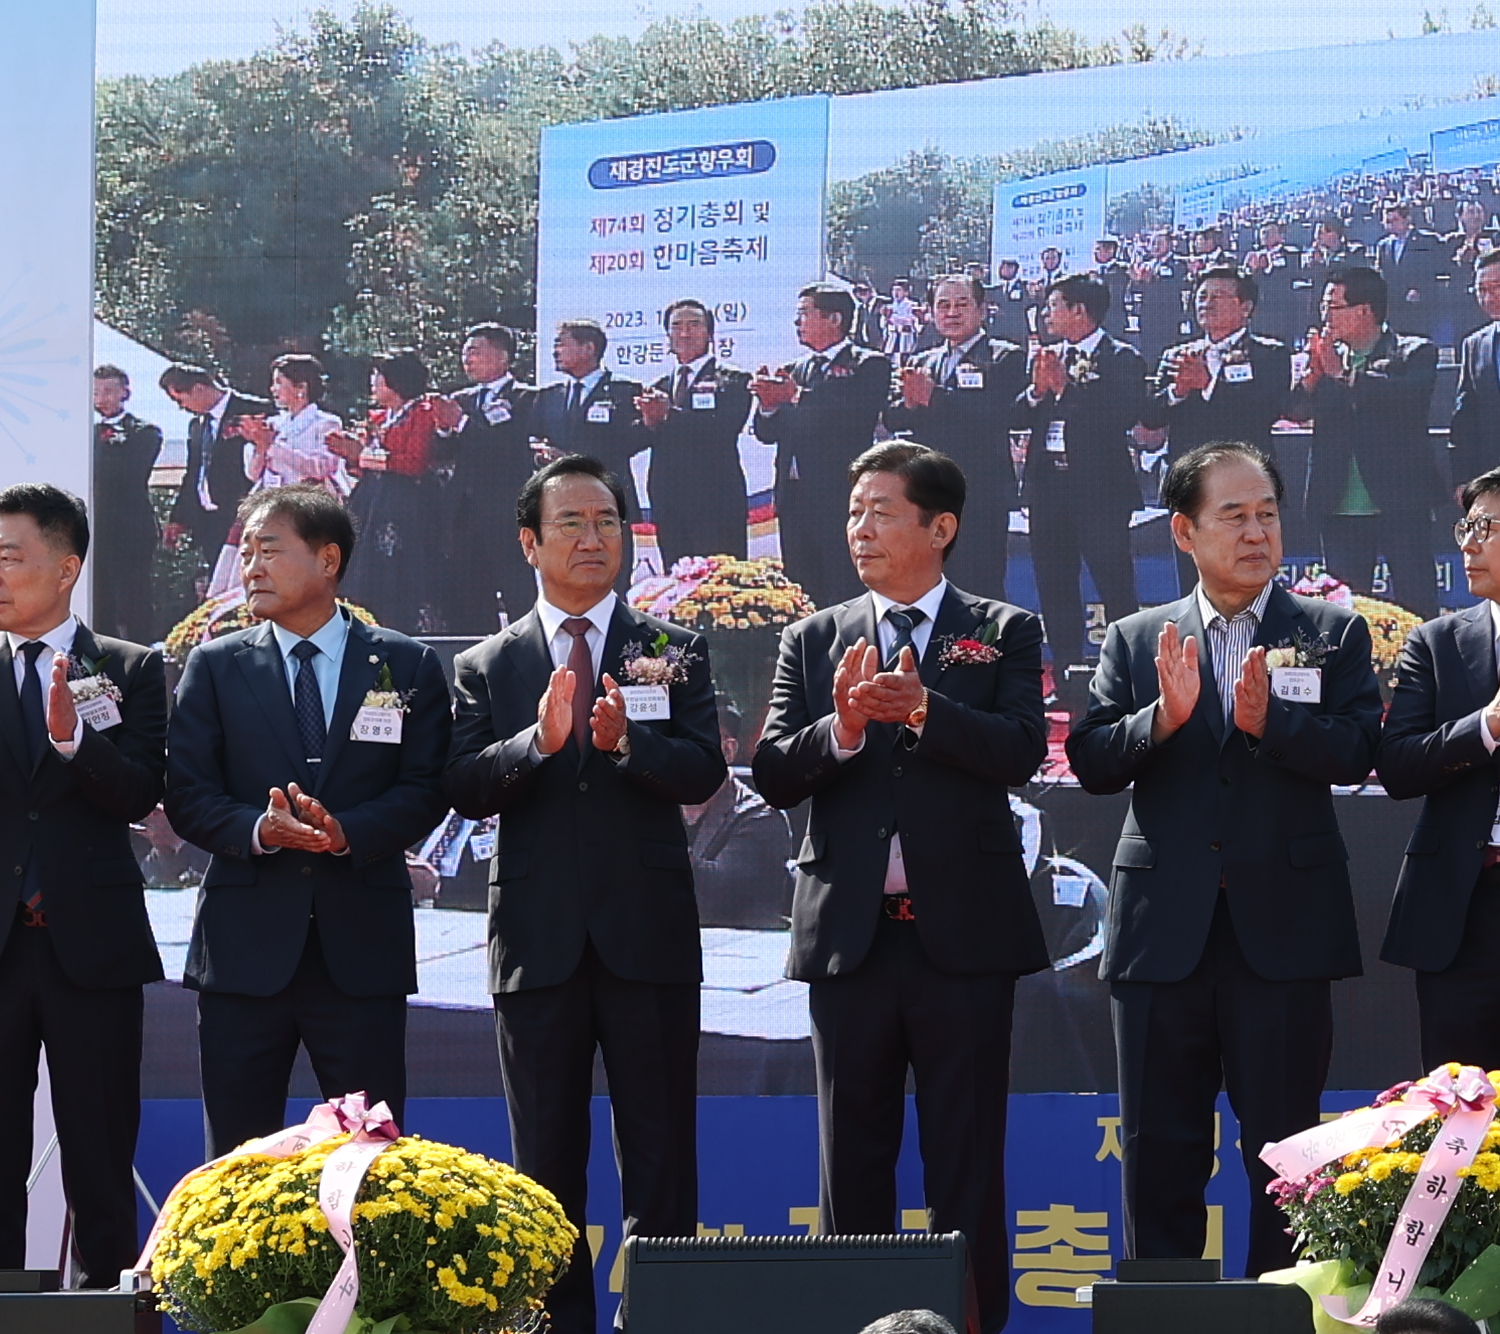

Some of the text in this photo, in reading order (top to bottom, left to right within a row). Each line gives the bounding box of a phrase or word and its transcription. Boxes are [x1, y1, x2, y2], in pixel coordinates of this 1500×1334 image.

[609, 145, 753, 181] 재경진도군향우회
[589, 200, 770, 237] 제74회 정기총회 및
[589, 235, 769, 275] 제20회 한마음축제
